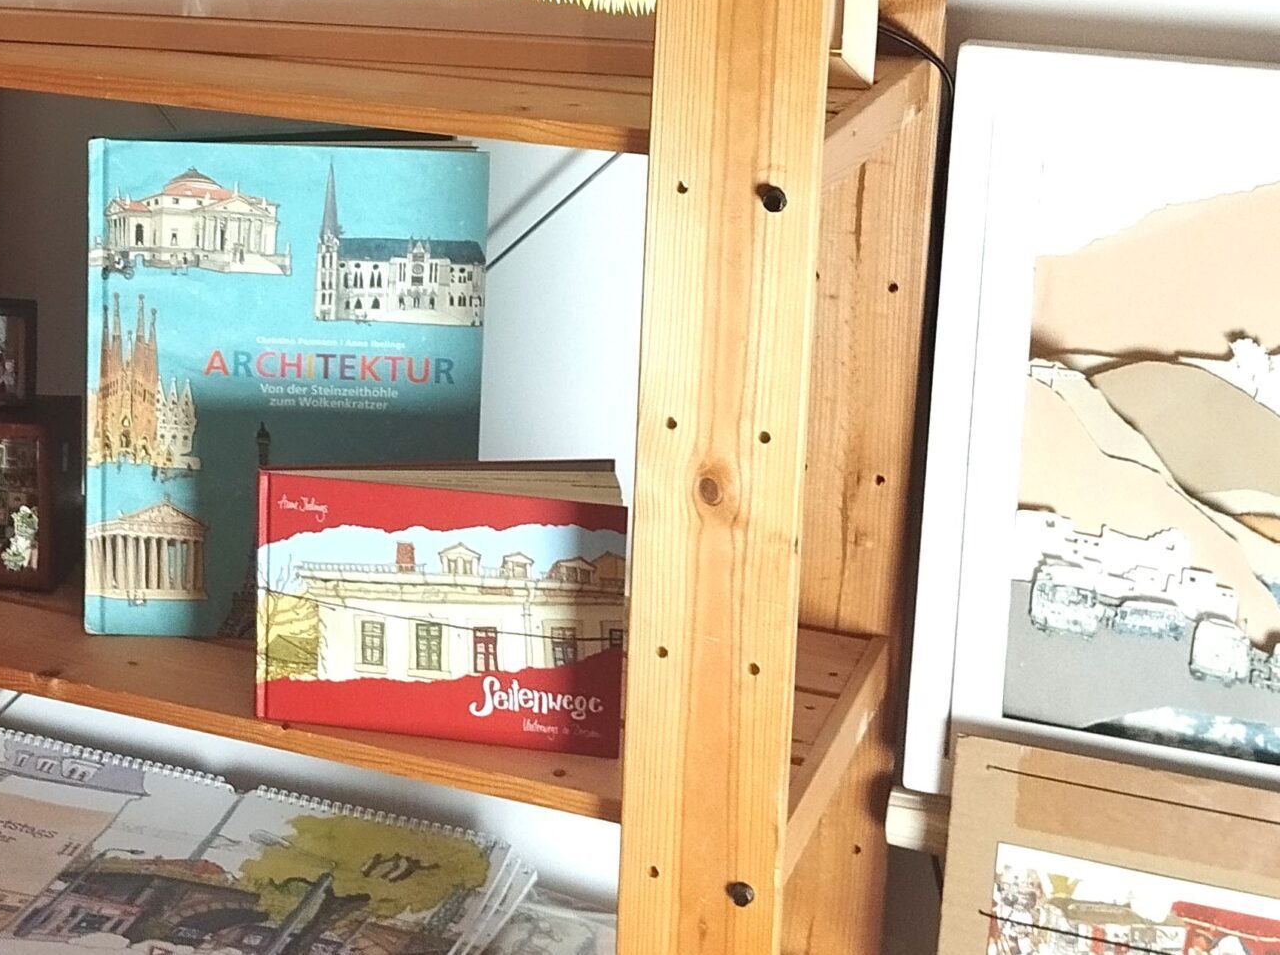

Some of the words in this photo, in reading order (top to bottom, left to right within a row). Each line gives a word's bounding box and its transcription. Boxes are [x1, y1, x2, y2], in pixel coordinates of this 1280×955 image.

[203, 348, 456, 385] ARCHITEKTUR
[260, 383, 284, 394] Von
[286, 383, 308, 395] der
[310, 384, 399, 399] Steinzeithöhle
[269, 397, 296, 407] zum
[298, 397, 389, 411] Wolkenkratzer
[469, 675, 604, 720] Seitenwege
